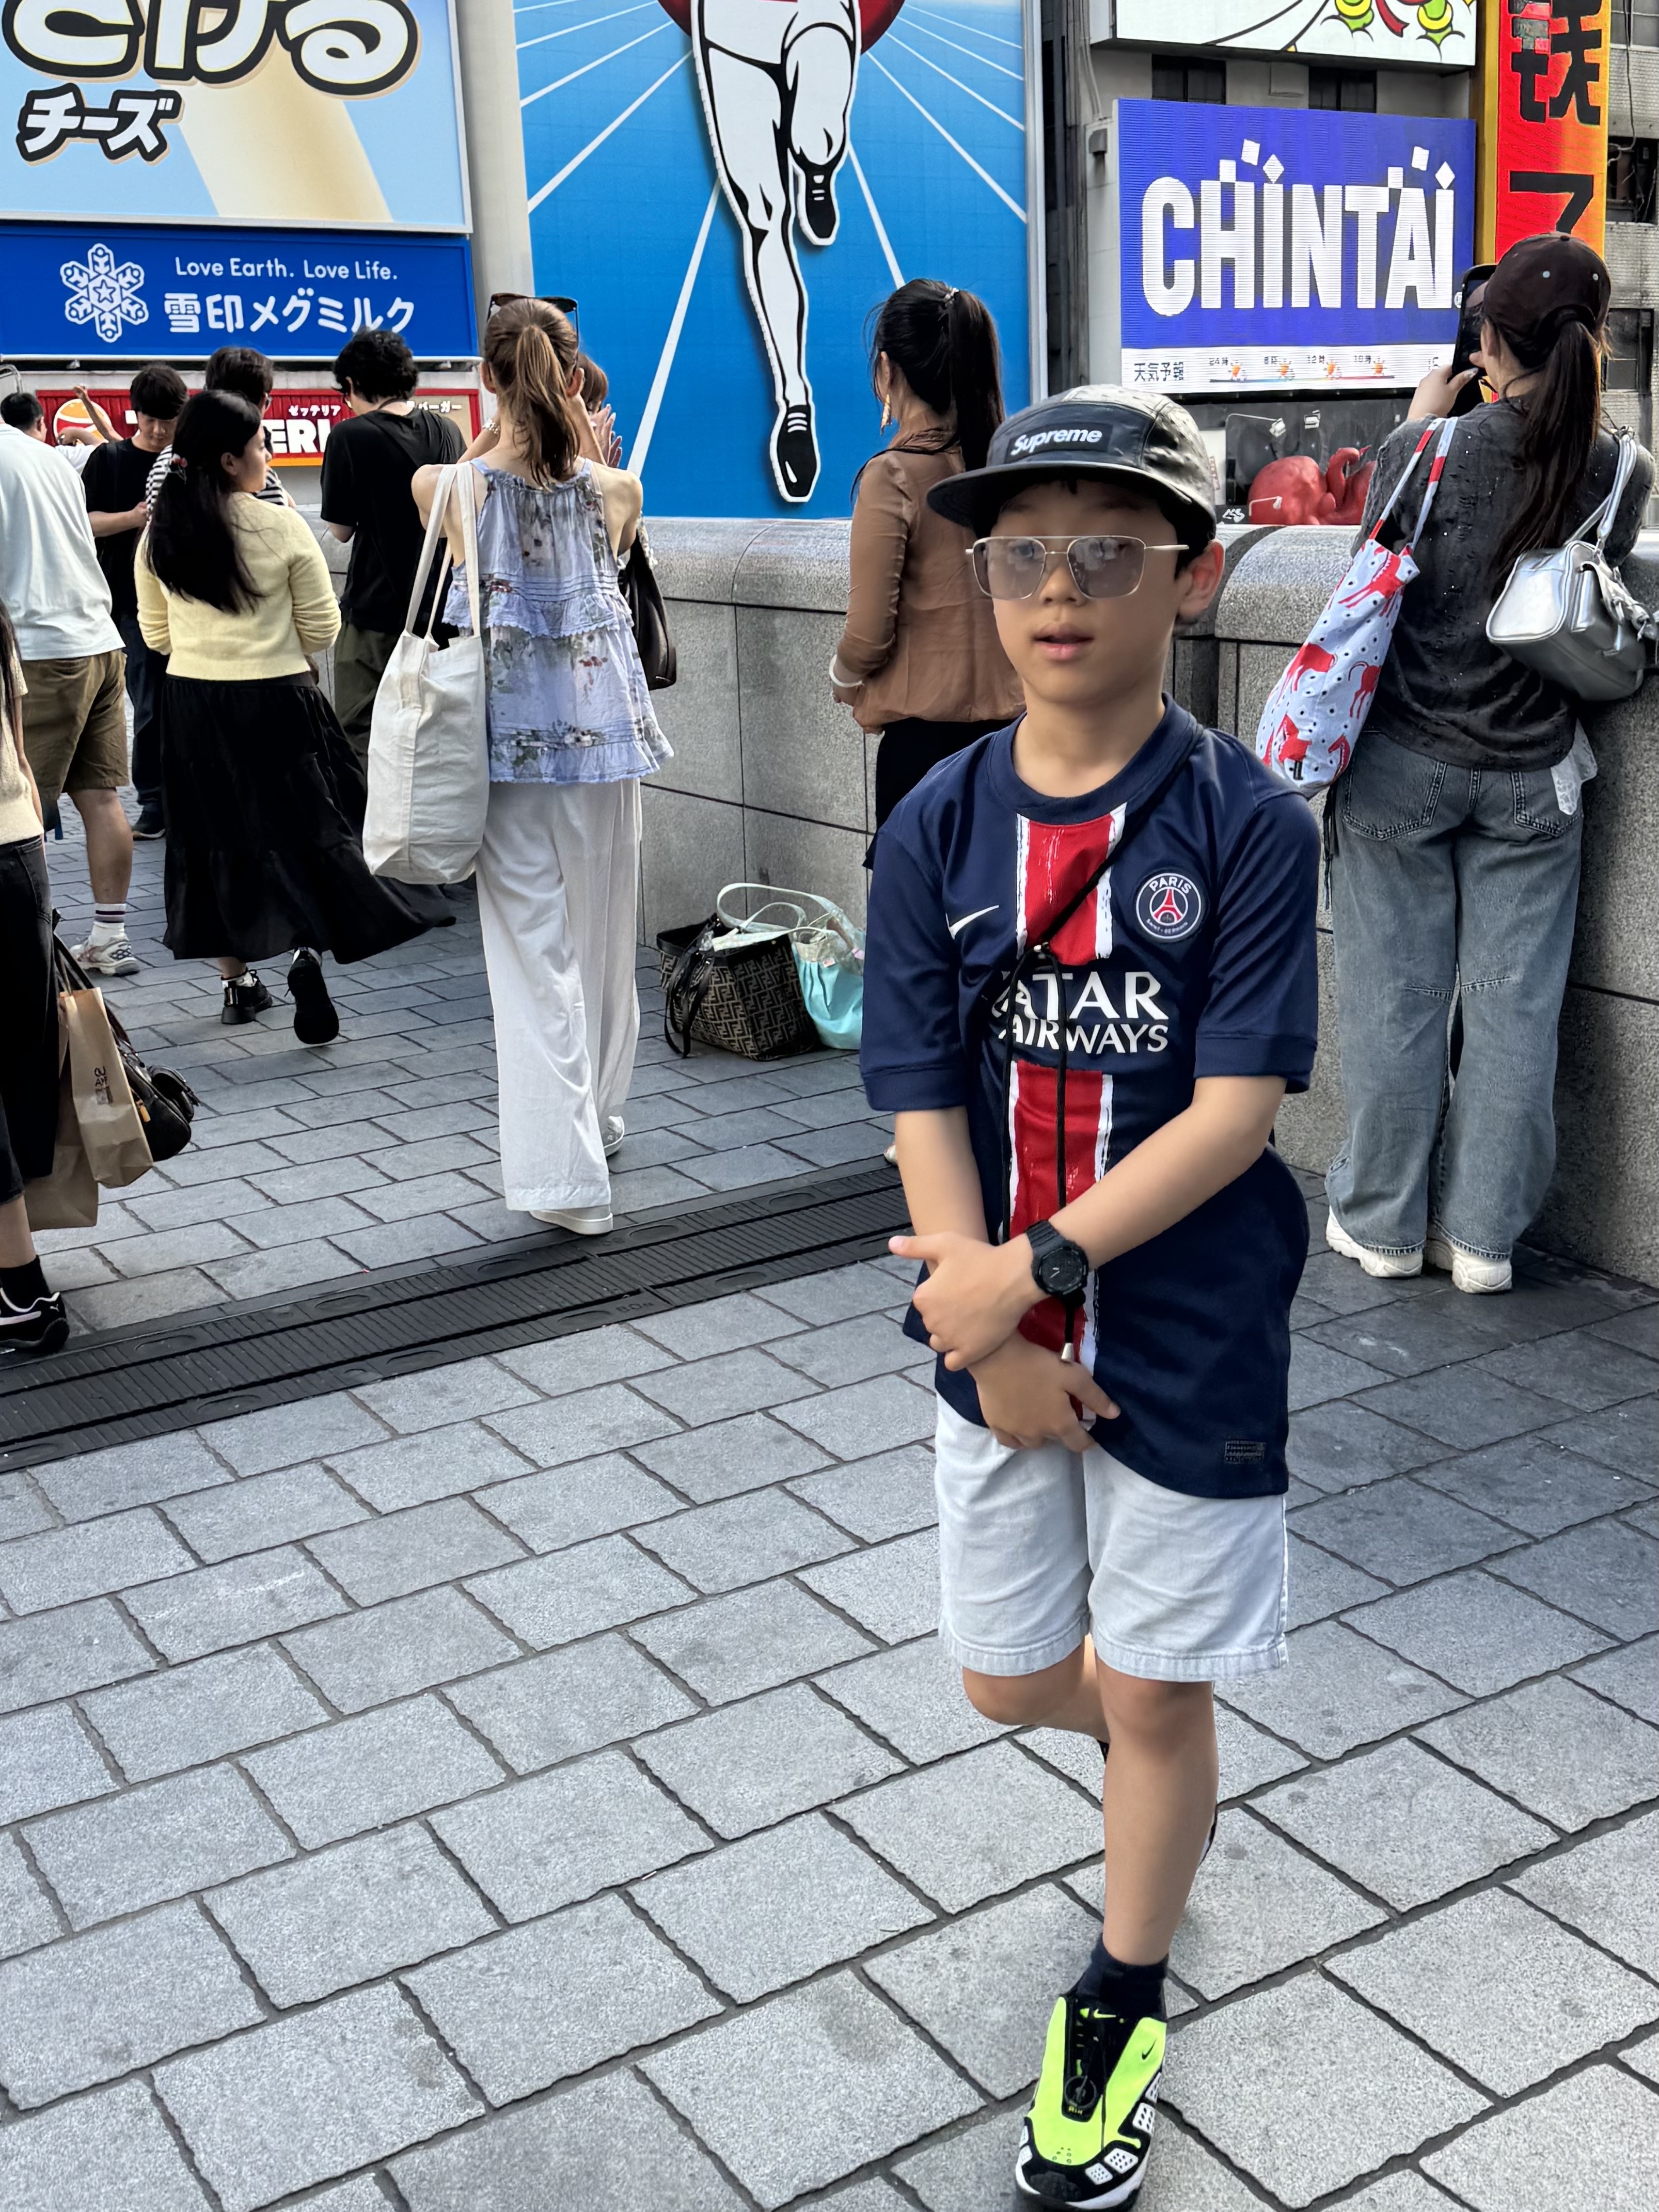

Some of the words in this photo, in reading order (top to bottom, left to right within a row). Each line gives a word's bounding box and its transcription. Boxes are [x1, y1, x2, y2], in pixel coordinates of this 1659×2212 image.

[21, 88, 177, 156] チーズ
[1141, 150, 1455, 317] CHINTAI
[176, 256, 224, 277] Love
[230, 257, 294, 278] Earth.
[303, 259, 350, 279] Love
[354, 259, 398, 280] Life.
[164, 287, 415, 334] 雪印メグミルク
[1010, 428, 1103, 455] Supreme
[1149, 877, 1192, 894] PARIS
[998, 1013, 1169, 1054] AIRWAYS
